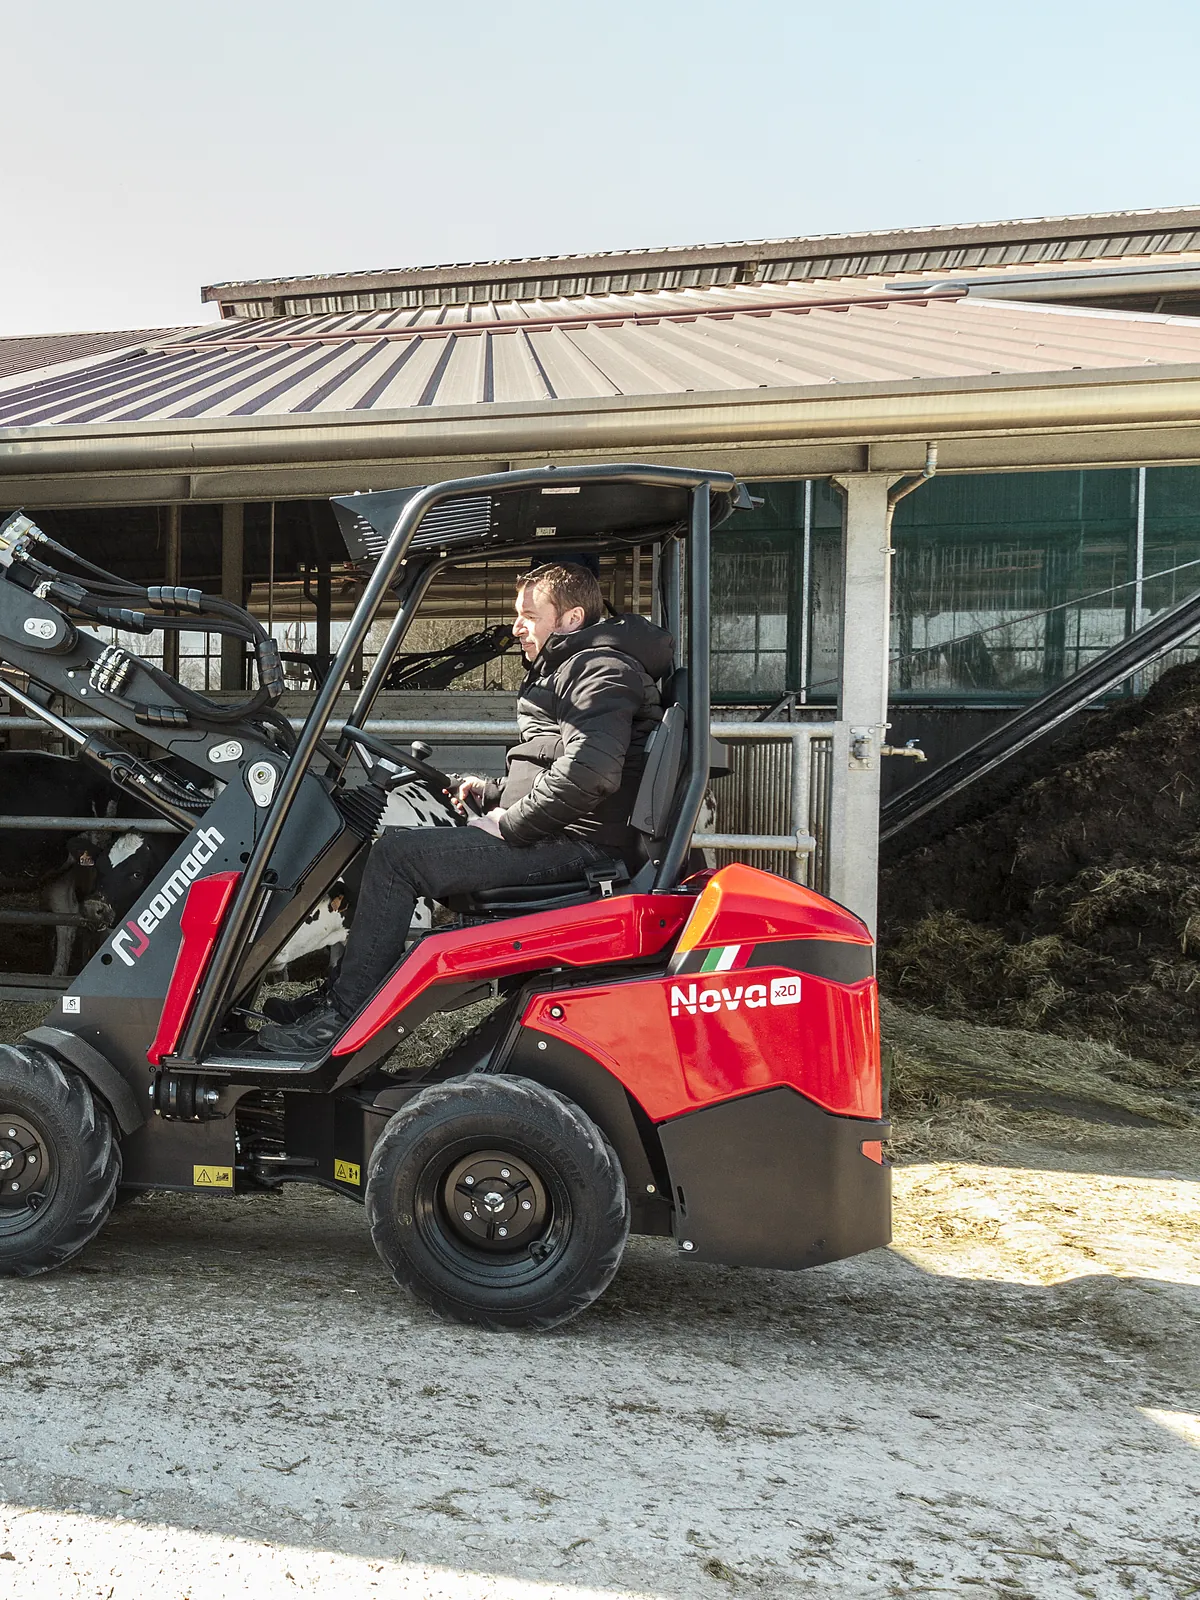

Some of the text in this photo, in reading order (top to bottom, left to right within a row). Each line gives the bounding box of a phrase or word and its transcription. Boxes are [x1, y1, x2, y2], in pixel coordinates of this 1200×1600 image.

[111, 826, 226, 967] Neomach
[670, 983, 797, 1017] Nova x20
